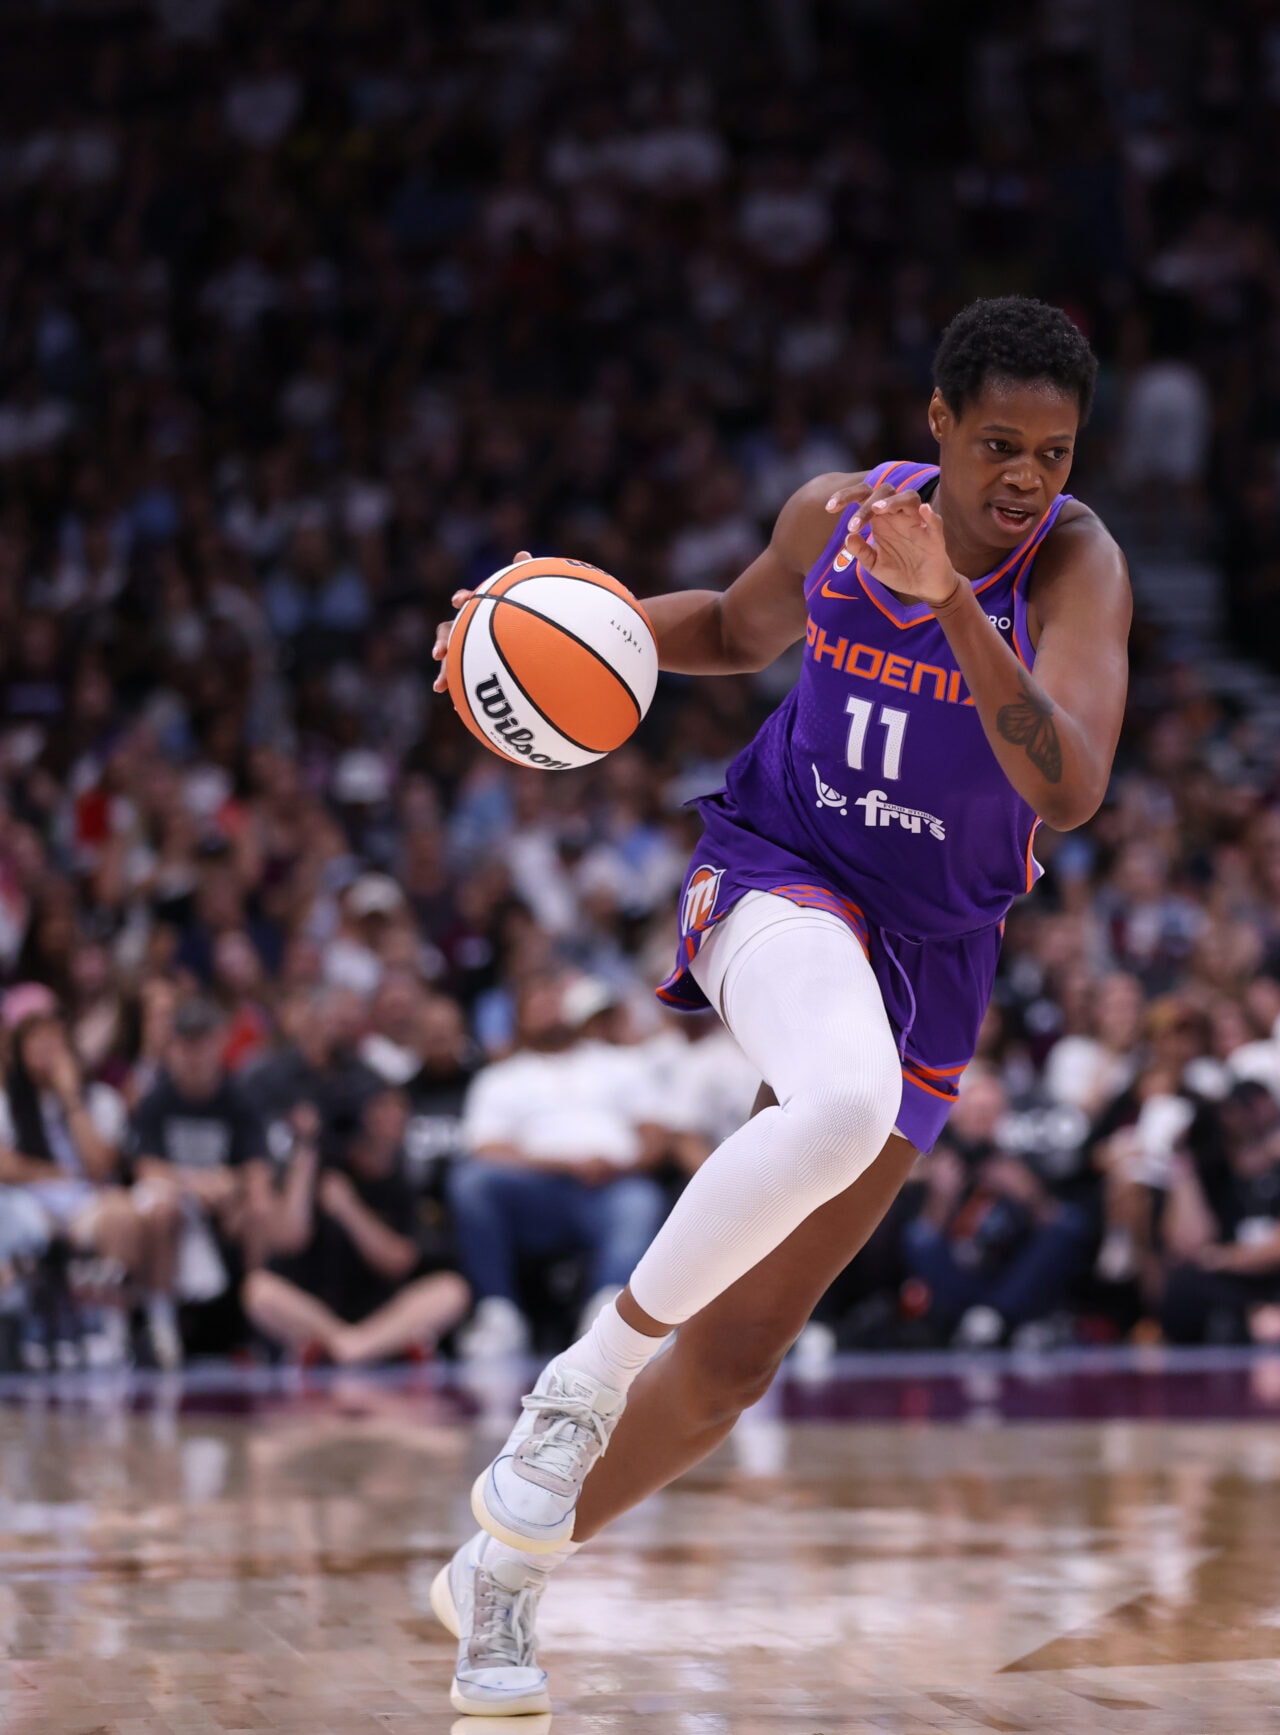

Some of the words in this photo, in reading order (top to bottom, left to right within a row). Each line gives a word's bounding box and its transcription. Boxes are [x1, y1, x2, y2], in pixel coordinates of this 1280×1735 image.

[807, 616, 975, 707] PHOENI
[475, 672, 572, 768] Wilson
[845, 696, 908, 780] 11
[854, 789, 946, 841] fry's
